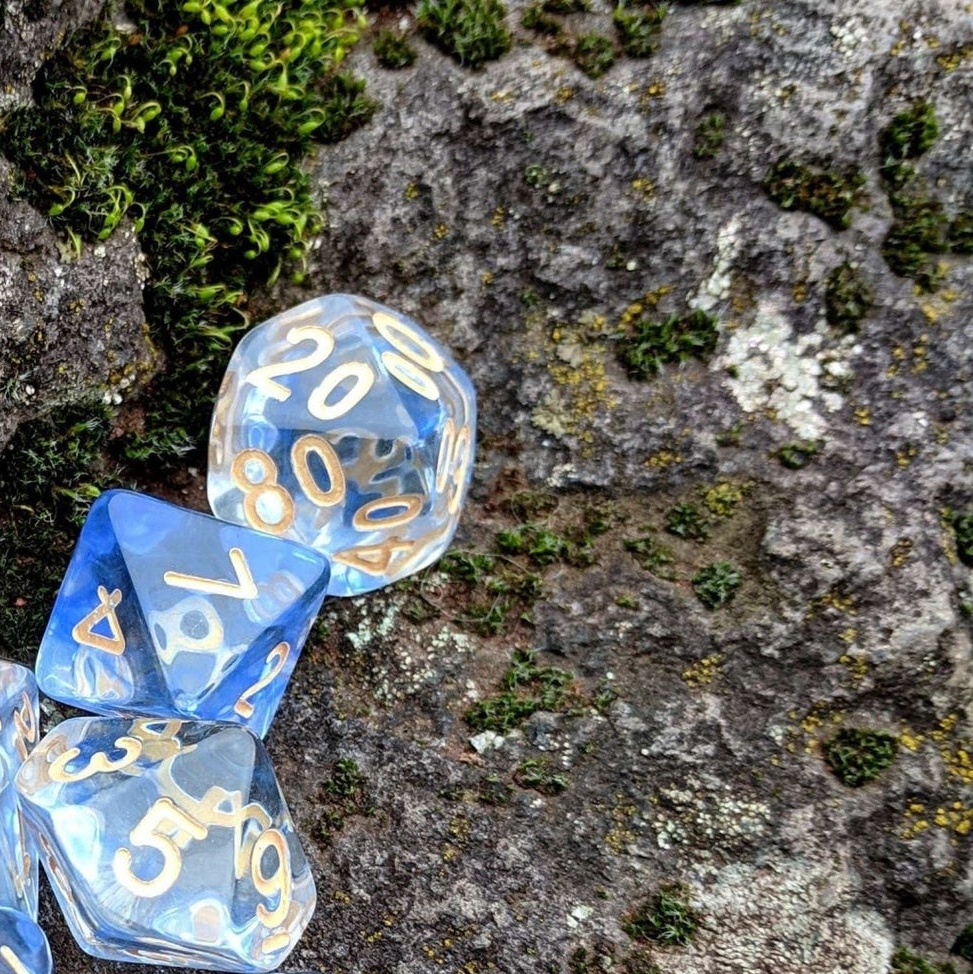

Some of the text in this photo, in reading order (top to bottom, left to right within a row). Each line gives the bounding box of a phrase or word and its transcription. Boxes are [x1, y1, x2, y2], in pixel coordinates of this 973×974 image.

[245, 326, 375, 420] 20
[373, 312, 444, 400] 00
[231, 434, 346, 535] 80
[163, 547, 258, 599] 7
[72, 585, 125, 656] 4
[48, 737, 142, 783] 3
[113, 797, 208, 898] 5
